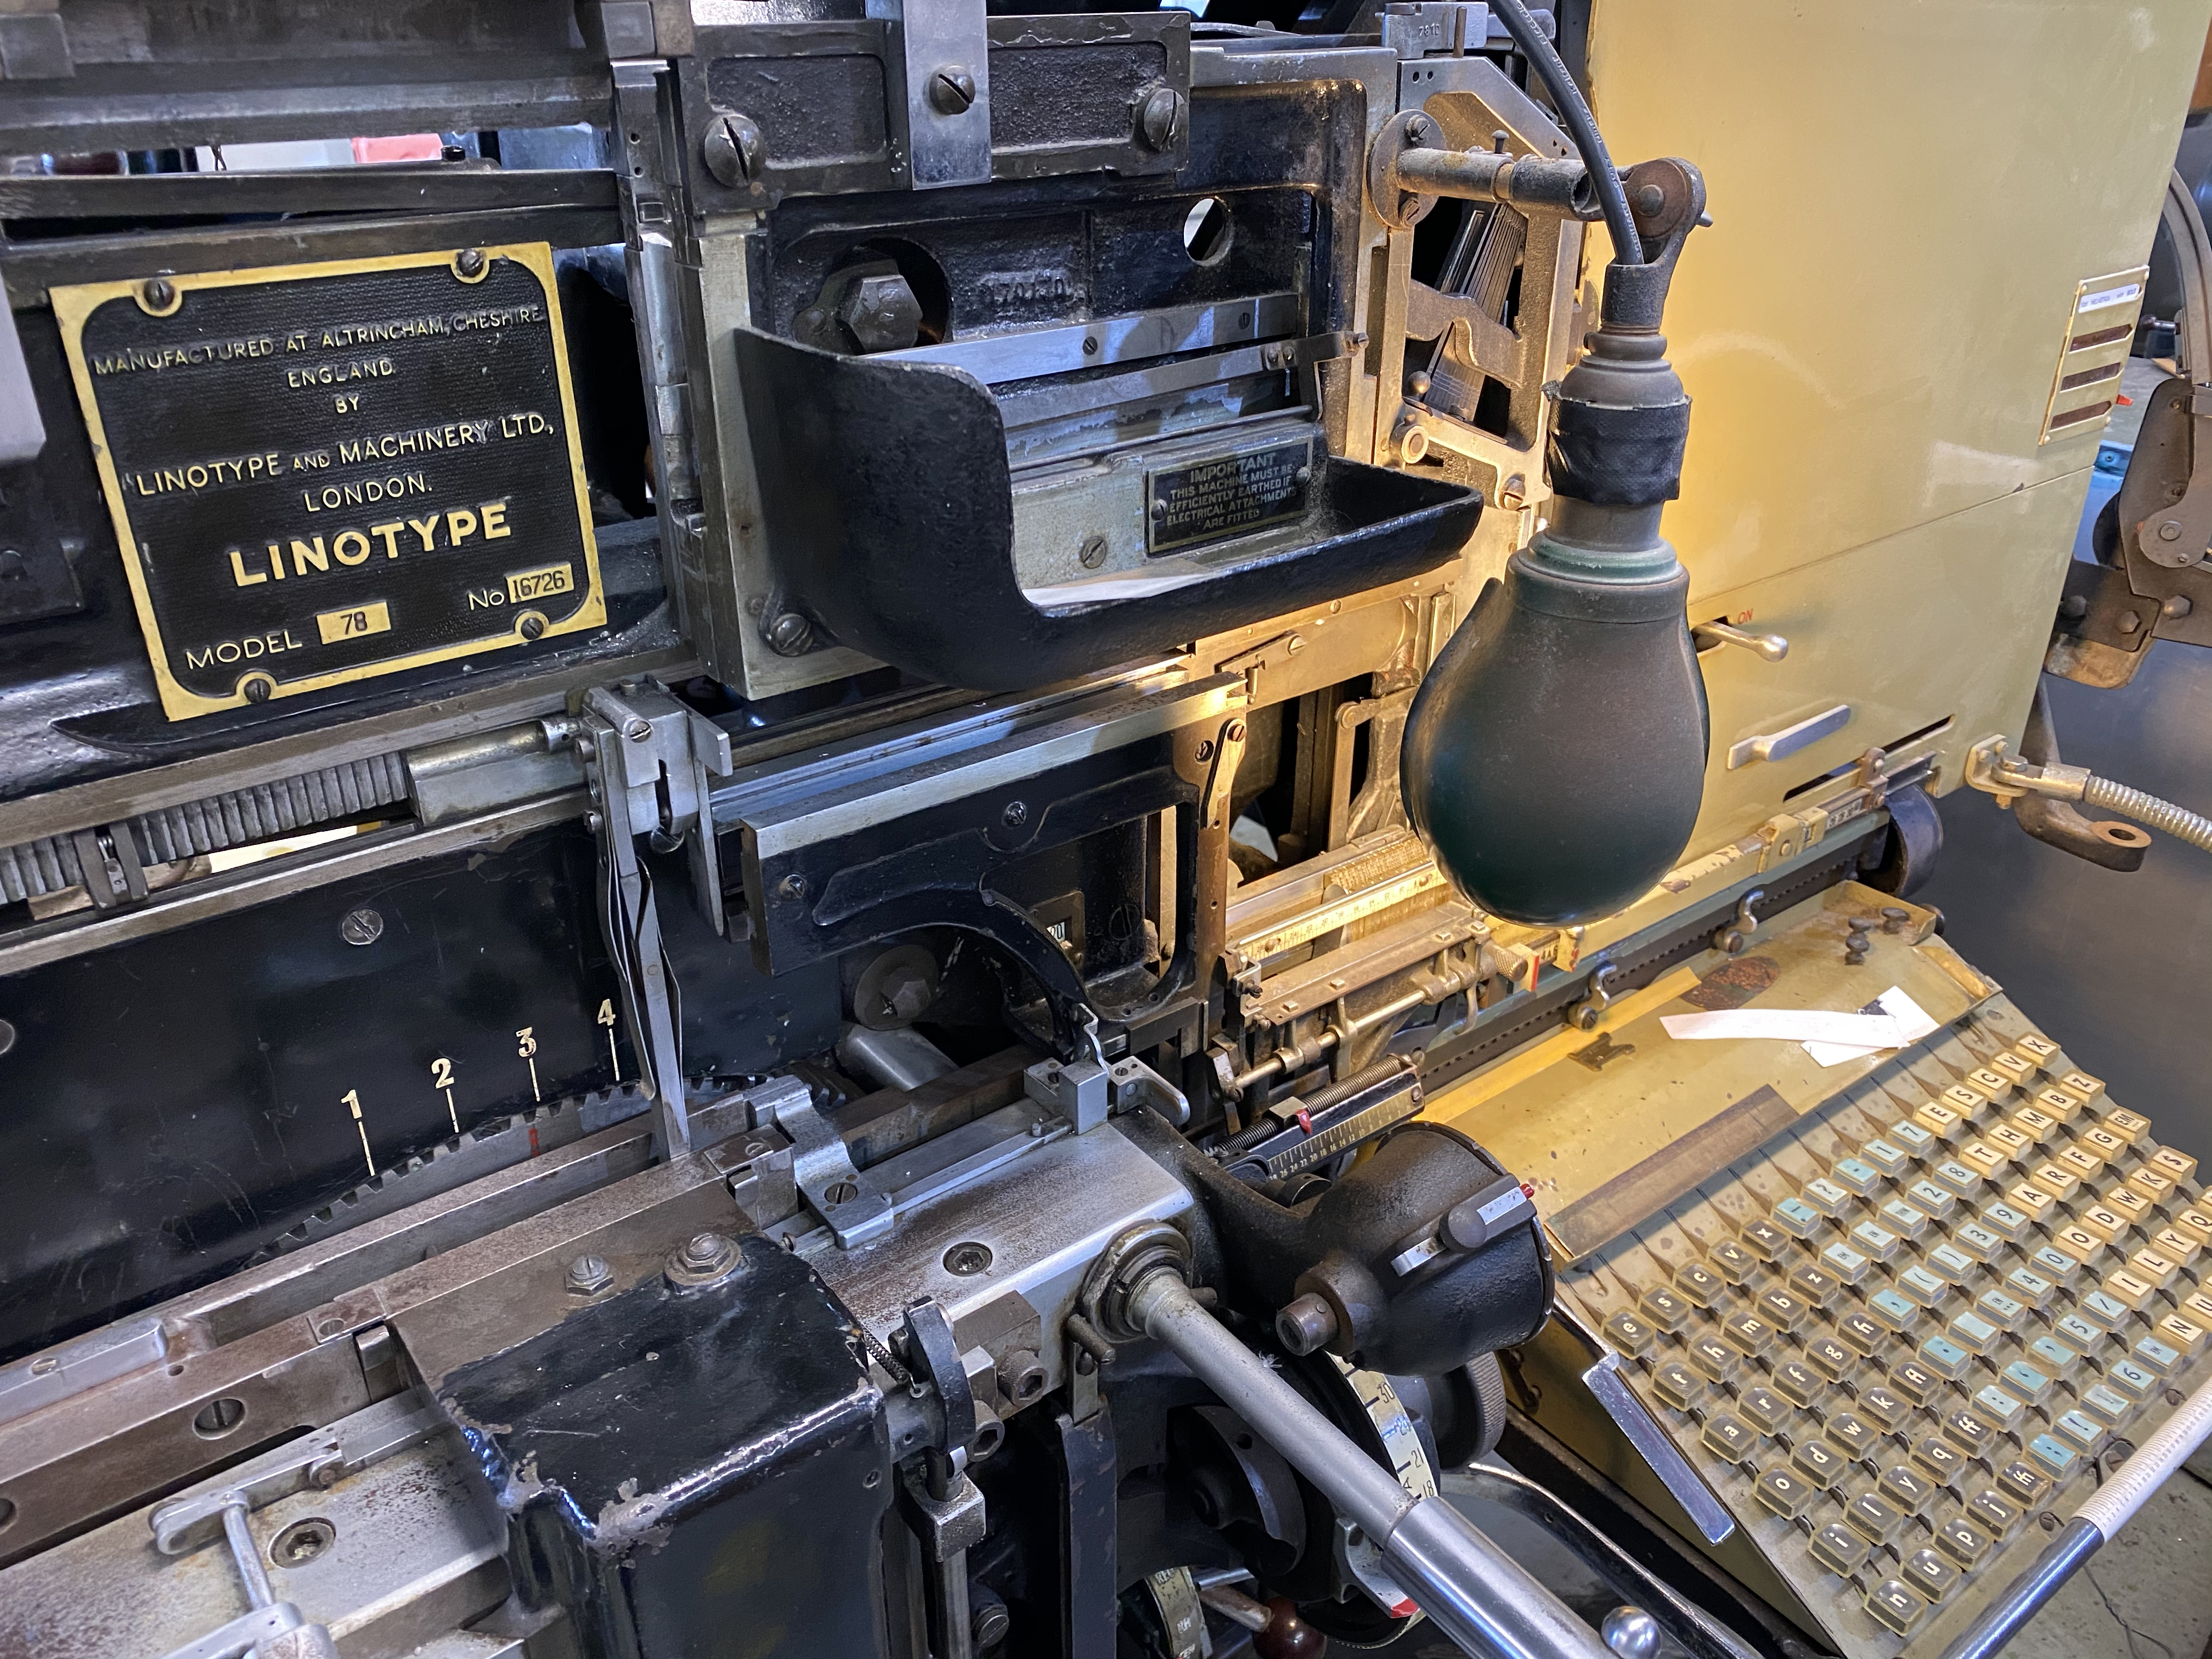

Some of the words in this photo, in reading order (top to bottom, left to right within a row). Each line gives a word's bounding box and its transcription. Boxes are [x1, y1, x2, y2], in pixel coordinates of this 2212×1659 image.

[95, 339, 274, 375] MANUFACTURED
[286, 335, 308, 352] AT
[287, 359, 393, 388] ENGLAND
[335, 394, 359, 414] BY
[137, 454, 279, 497] LINOTYPE
[292, 453, 330, 472] AND
[340, 422, 489, 465] MACHINERY
[1190, 453, 1277, 483] IMPORTANT
[1170, 489, 1195, 500] THIS
[1199, 475, 1248, 494] MACHINE
[1251, 467, 1278, 482] MUST
[1279, 464, 1293, 474] BE
[304, 473, 432, 512] LONDON.
[1169, 490, 1235, 514] EFFICIENTLY
[1238, 479, 1281, 498] EARTHED
[1283, 476, 1292, 487] IF
[1166, 507, 1226, 526] ELECTRICAL
[1203, 518, 1224, 529] ARE
[1227, 509, 1260, 524] FITTED
[229, 503, 511, 586] LINOTYPE
[469, 590, 505, 610] No
[514, 570, 565, 599] 16726
[1737, 608, 1753, 624] ON
[187, 630, 302, 670] MODEL
[340, 612, 368, 635] 78
[597, 998, 616, 1025] 4
[516, 1026, 537, 1057] 3
[2028, 1040, 2047, 1049] X
[2008, 1057, 2021, 1065] V
[431, 1058, 454, 1088] 2
[1982, 1074, 1999, 1082] C
[2073, 1077, 2091, 1088] Z
[1956, 1091, 1973, 1099] S
[2050, 1095, 2066, 1103] B
[341, 1089, 362, 1119] 1
[1931, 1108, 1947, 1117] E
[2025, 1112, 2045, 1124] M
[1903, 1126, 1918, 1136] 7
[2000, 1130, 2020, 1141] H
[2095, 1133, 2112, 1143] G
[1290, 1163, 1298, 1172] 24
[1300, 1159, 1307, 1167] 22
[1310, 1153, 1317, 1162] 20
[1320, 1148, 1327, 1157] 18
[1330, 1143, 1336, 1152] 16
[1339, 1138, 1346, 1147] 14
[1349, 1133, 1356, 1142] 12
[1358, 1128, 1365, 1137] 10
[1974, 1148, 1992, 1158] T
[2070, 1152, 2086, 1161] F
[1949, 1167, 1965, 1177] 8
[2047, 1171, 2067, 1180] R
[2141, 1173, 2162, 1184] K
[1923, 1188, 1942, 1198] 2
[2023, 1190, 2041, 1201] A
[2116, 1192, 2138, 1204] W
[1997, 1210, 2012, 1219] 9
[2096, 1214, 2114, 1223] D
[2191, 1216, 2212, 1227] Q
[1757, 1228, 1773, 1238] x
[1970, 1231, 1988, 1240] 3
[2165, 1234, 2185, 1245] Y
[1725, 1249, 1739, 1259] v
[2144, 1258, 2164, 1267] L
[1694, 1273, 1707, 1282] c
[1808, 1273, 1822, 1283] z
[2023, 1275, 2040, 1284] 4
[1658, 1297, 1671, 1307] s
[1770, 1296, 1790, 1308] b
[1623, 1323, 1636, 1333] e
[1741, 1320, 1760, 1333] m
[2069, 1321, 2087, 1334] 5
[2170, 1320, 2192, 1334] N
[1703, 1345, 1725, 1358] h
[1825, 1345, 1842, 1359] g
[1672, 1373, 1687, 1384] t
[1789, 1367, 1805, 1381] f
[2124, 1368, 2141, 1380] 6
[1377, 1383, 1395, 1403] 30
[1758, 1398, 1771, 1409] r
[1871, 1396, 1894, 1409] k
[1724, 1426, 1739, 1436] a
[1843, 1421, 1861, 1435] w
[1959, 1417, 1980, 1434] ff
[1411, 1447, 1424, 1468] 21
[1810, 1447, 1829, 1463] d
[1933, 1448, 1953, 1459] q
[1423, 1480, 1434, 1498] 18
[1776, 1479, 1790, 1489] o
[1899, 1476, 1917, 1492] y
[1983, 1500, 2006, 1517] j
[1830, 1533, 1848, 1548] i
[1956, 1532, 1974, 1547] p
[1923, 1562, 1940, 1575] u
[1889, 1594, 1907, 1607] n
